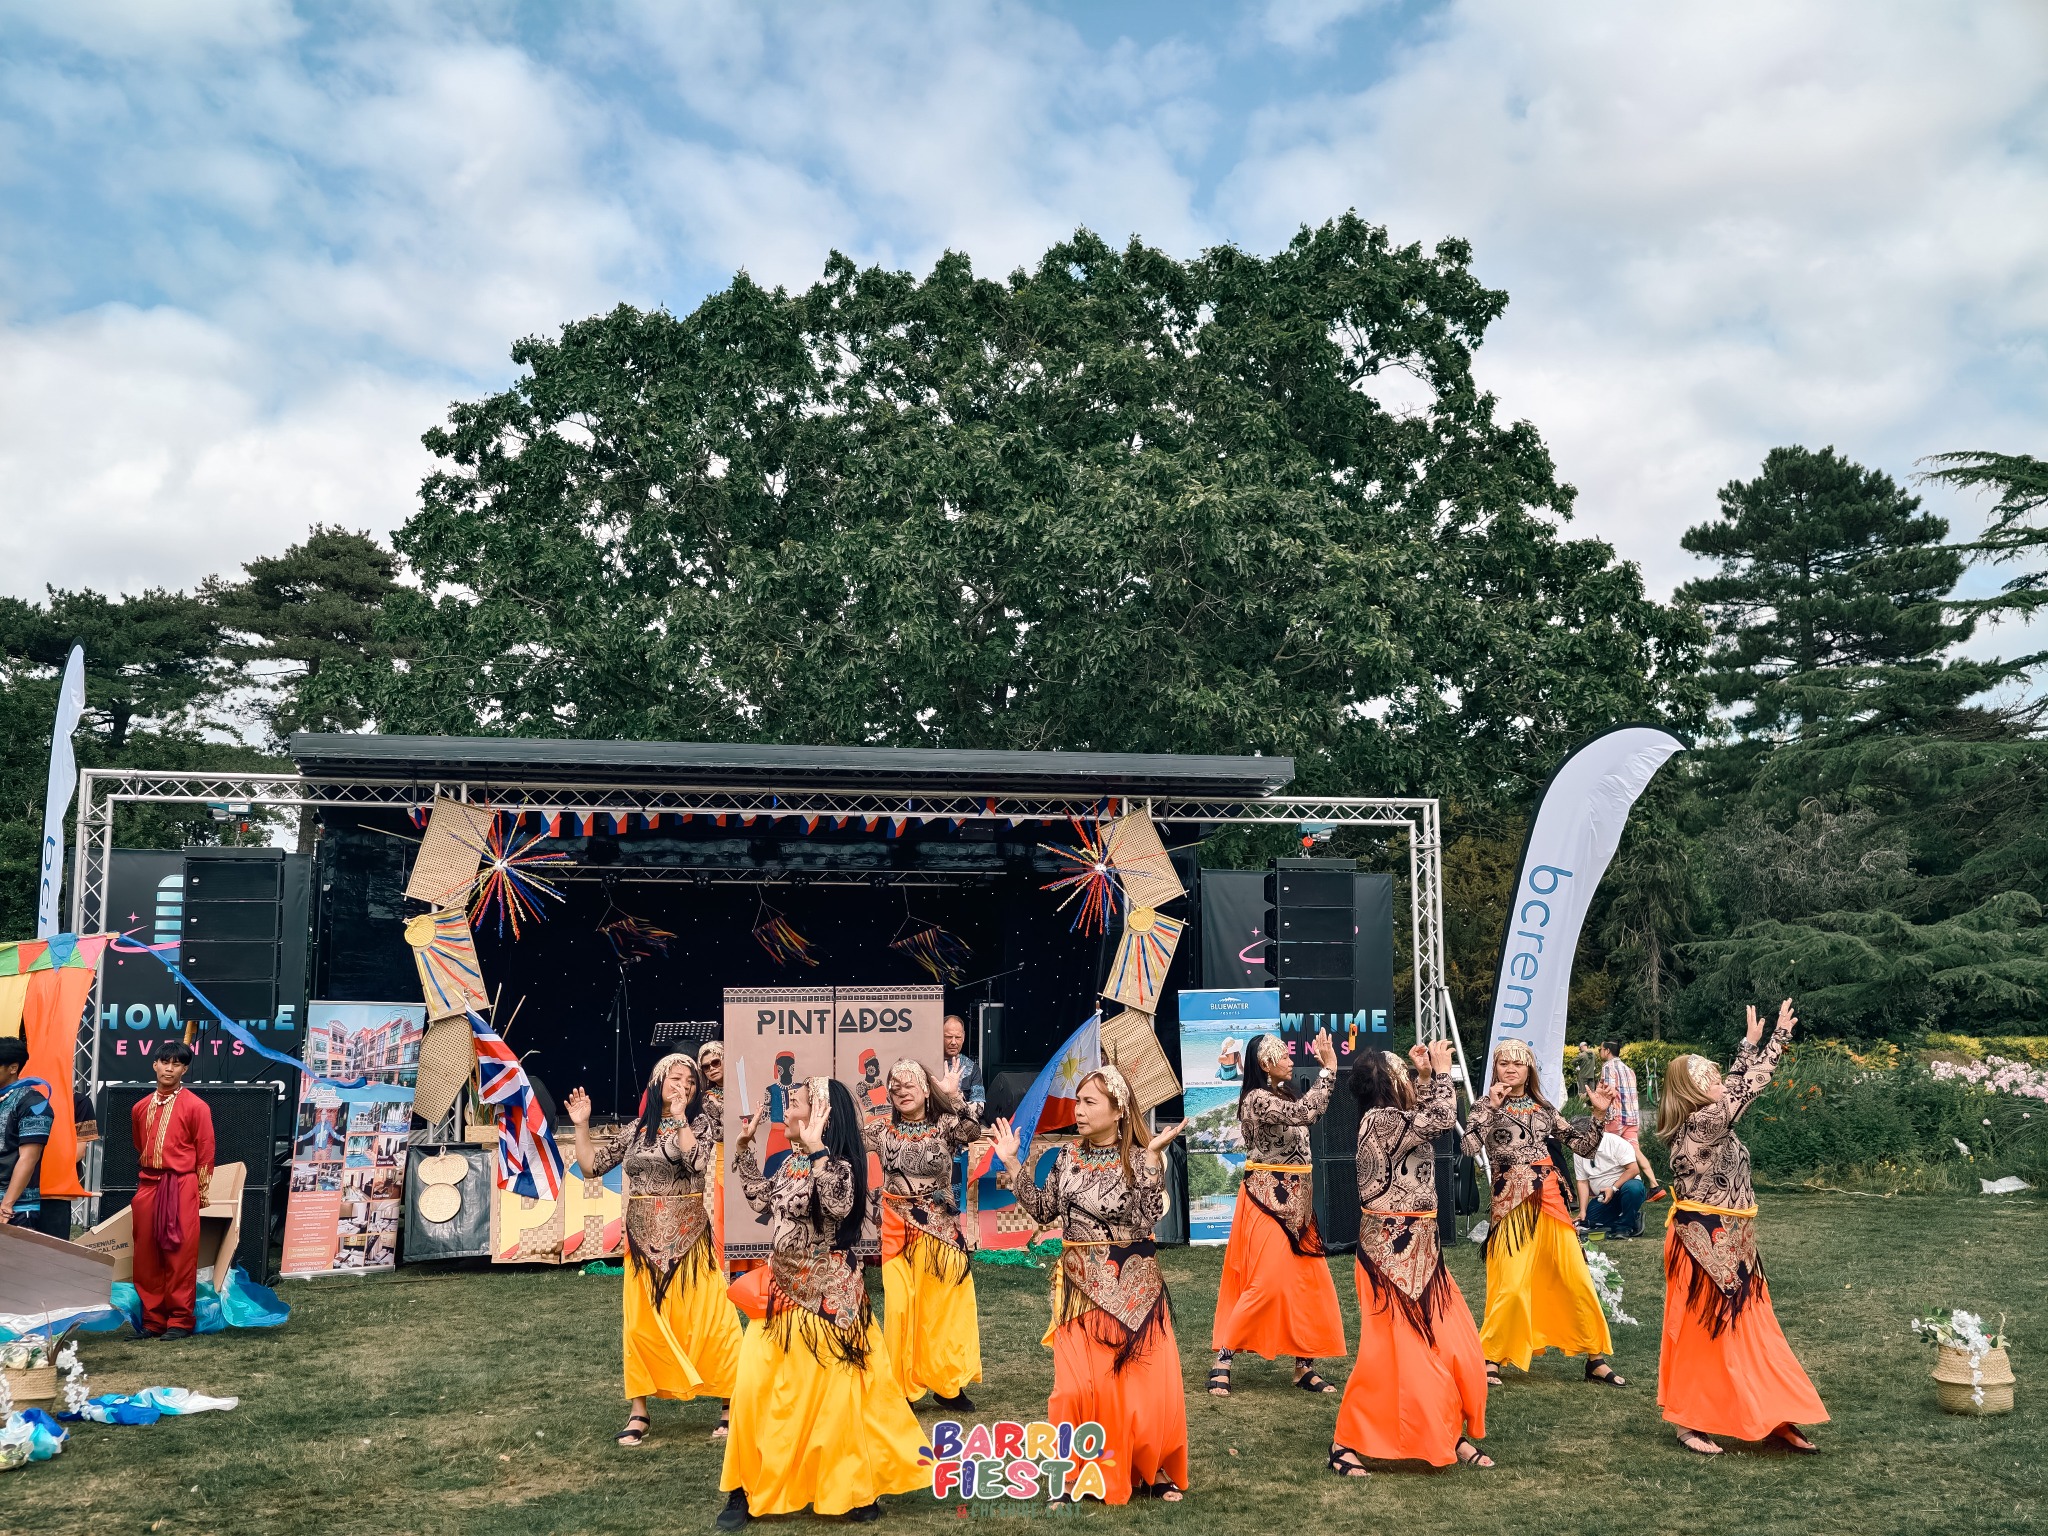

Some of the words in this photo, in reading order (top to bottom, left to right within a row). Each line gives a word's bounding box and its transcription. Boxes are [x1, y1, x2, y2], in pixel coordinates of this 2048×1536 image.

[1281, 1008, 1388, 1032] WTIME
[116, 1039, 246, 1057] EVNTS
[111, 1242, 129, 1251] CARE
